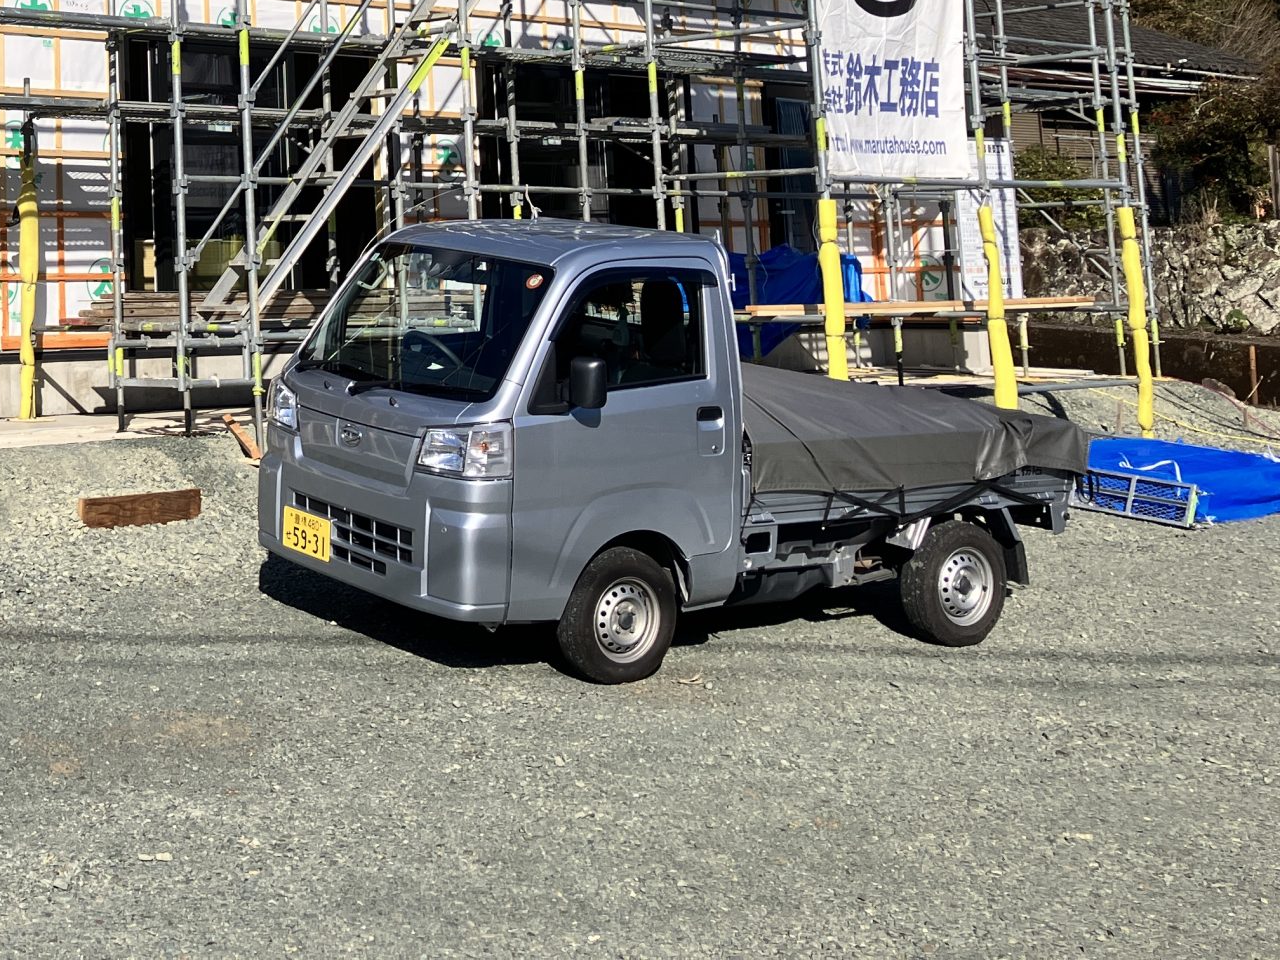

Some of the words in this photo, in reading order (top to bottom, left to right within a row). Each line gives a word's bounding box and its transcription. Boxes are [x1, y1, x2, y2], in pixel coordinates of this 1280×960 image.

[845, 52, 940, 118] 鈴木工務店
[293, 526, 325, 558] 59-31
